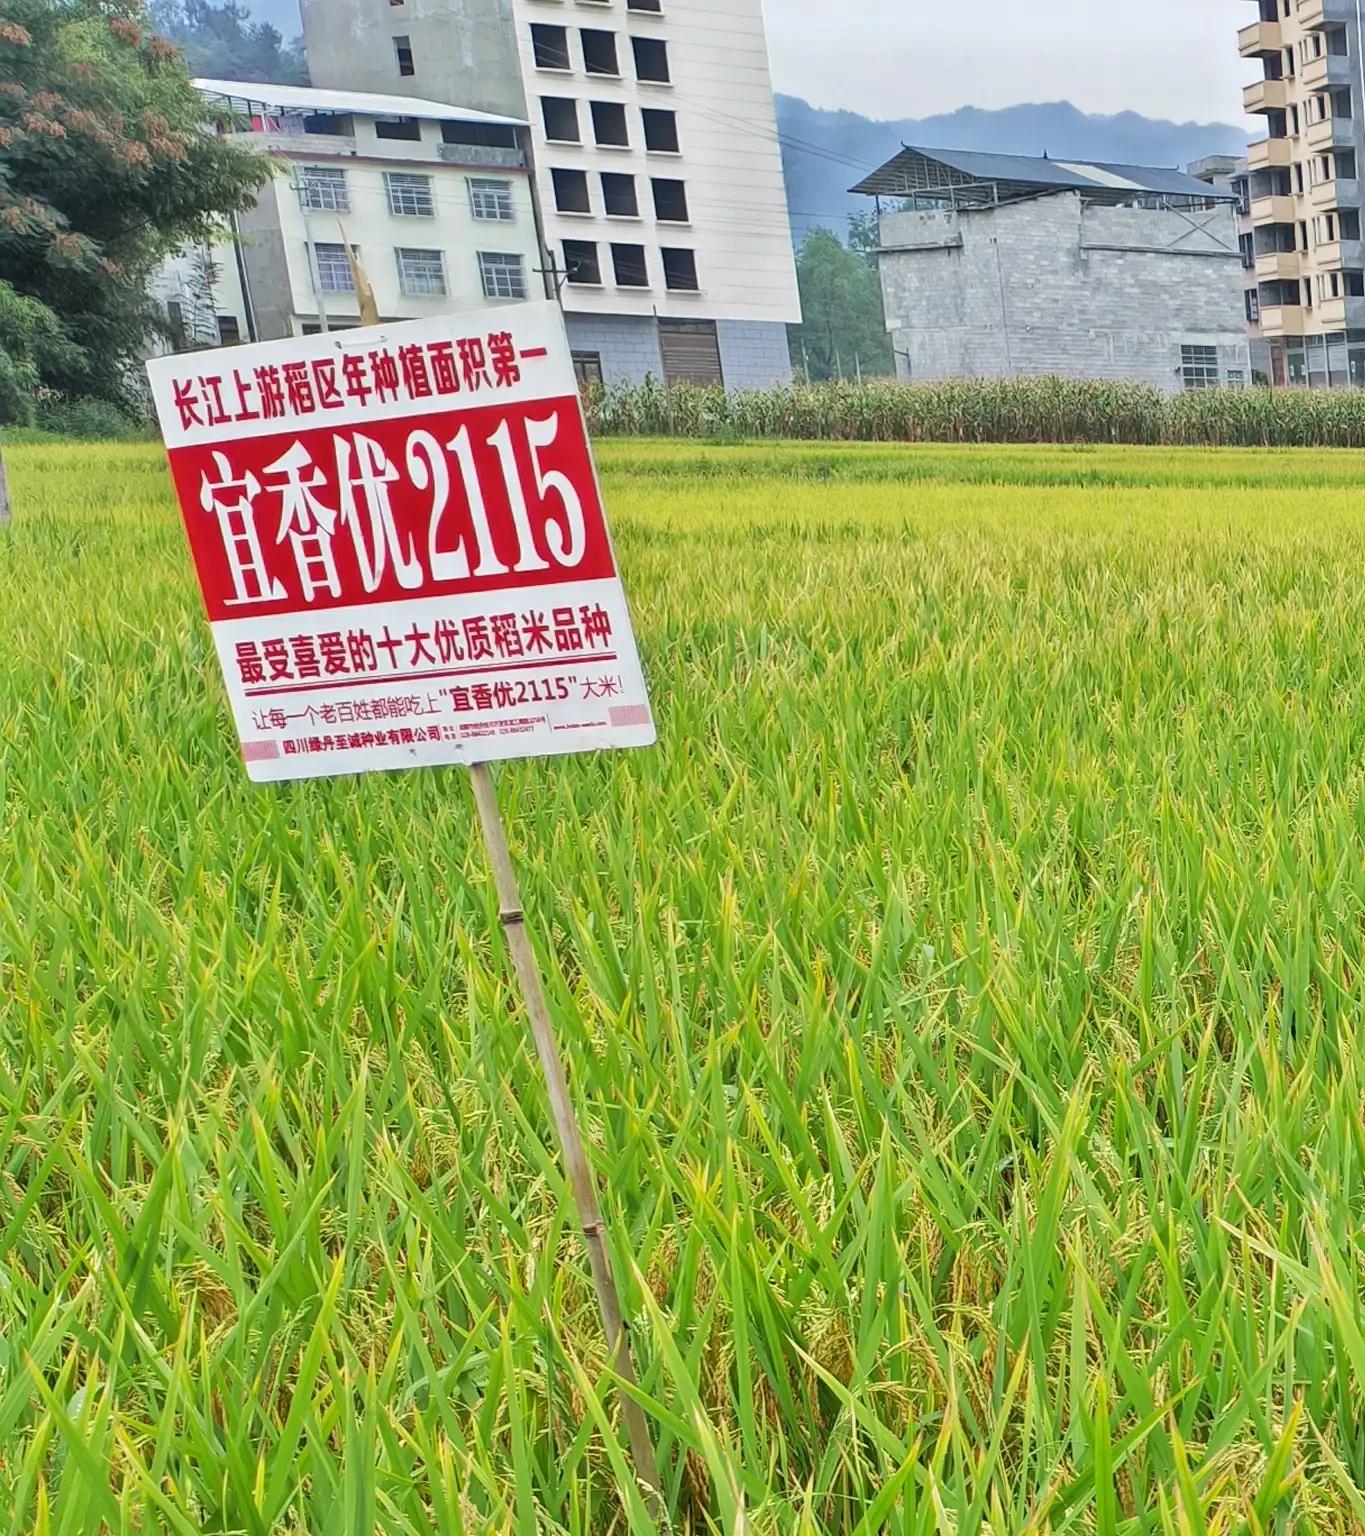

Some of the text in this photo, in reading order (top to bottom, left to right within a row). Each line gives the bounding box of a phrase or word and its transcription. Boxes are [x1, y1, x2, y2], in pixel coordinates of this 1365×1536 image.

[172, 331, 548, 432] 长江上游稻区年种植面积第一
[200, 410, 587, 606] 宜香优2115
[235, 602, 612, 685] 最受喜爱的十大优质稻米品种
